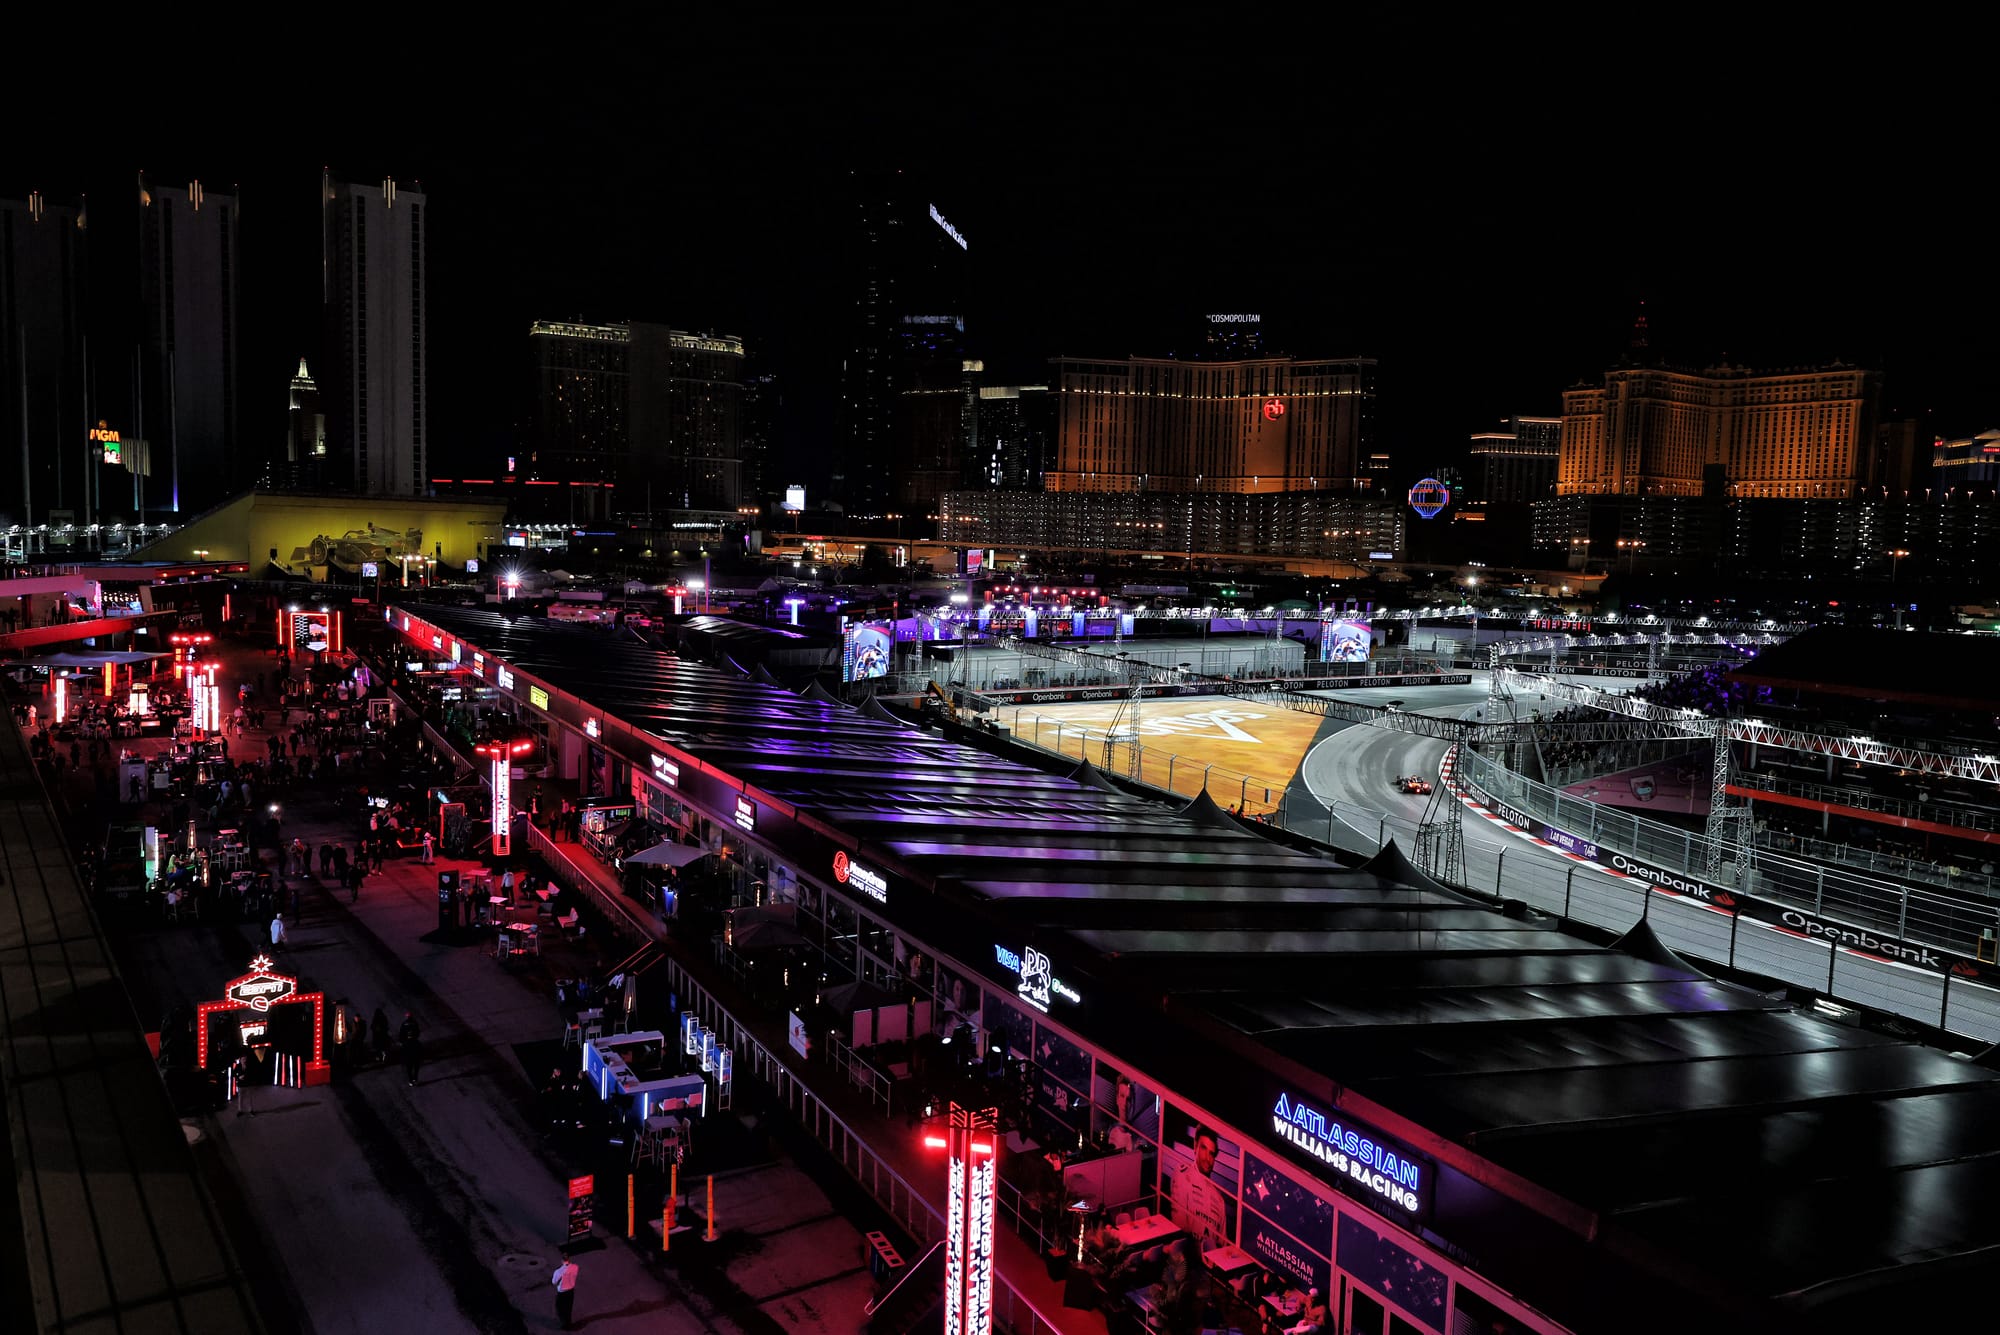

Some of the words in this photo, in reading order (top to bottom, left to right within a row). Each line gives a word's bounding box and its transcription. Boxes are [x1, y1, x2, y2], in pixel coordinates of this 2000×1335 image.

[1211, 314, 1261, 323] COSMOPOLITAN
[90, 428, 120, 442] MGM
[1316, 679, 1349, 689] PELOTON
[1359, 678, 1391, 687] PELOTON
[1401, 677, 1431, 685] PELOTON
[1440, 675, 1468, 684] PELOTON
[1592, 668, 1637, 677] PELOTON
[1032, 692, 1066, 703] Openbank
[1081, 689, 1113, 699] Openbank
[1469, 784, 1490, 808] PELOTON
[1497, 803, 1531, 830] PELOTON
[849, 860, 887, 892] MoneyGram
[1612, 855, 1712, 900] Openbank
[1782, 911, 1941, 968] Openbank
[994, 944, 1020, 973] VISA
[1292, 1103, 1419, 1191] ATLASSIAN
[956, 1158, 965, 1198] PRIX
[982, 1158, 994, 1197] PRIX
[1273, 1115, 1348, 1173] WILLIAMS
[1350, 1160, 1419, 1212] RACING
[954, 1200, 963, 1259] GRAND
[981, 1199, 993, 1257] GRAND
[1263, 1236, 1314, 1277] ATLASSIAN
[979, 1259, 992, 1314] VEGAS
